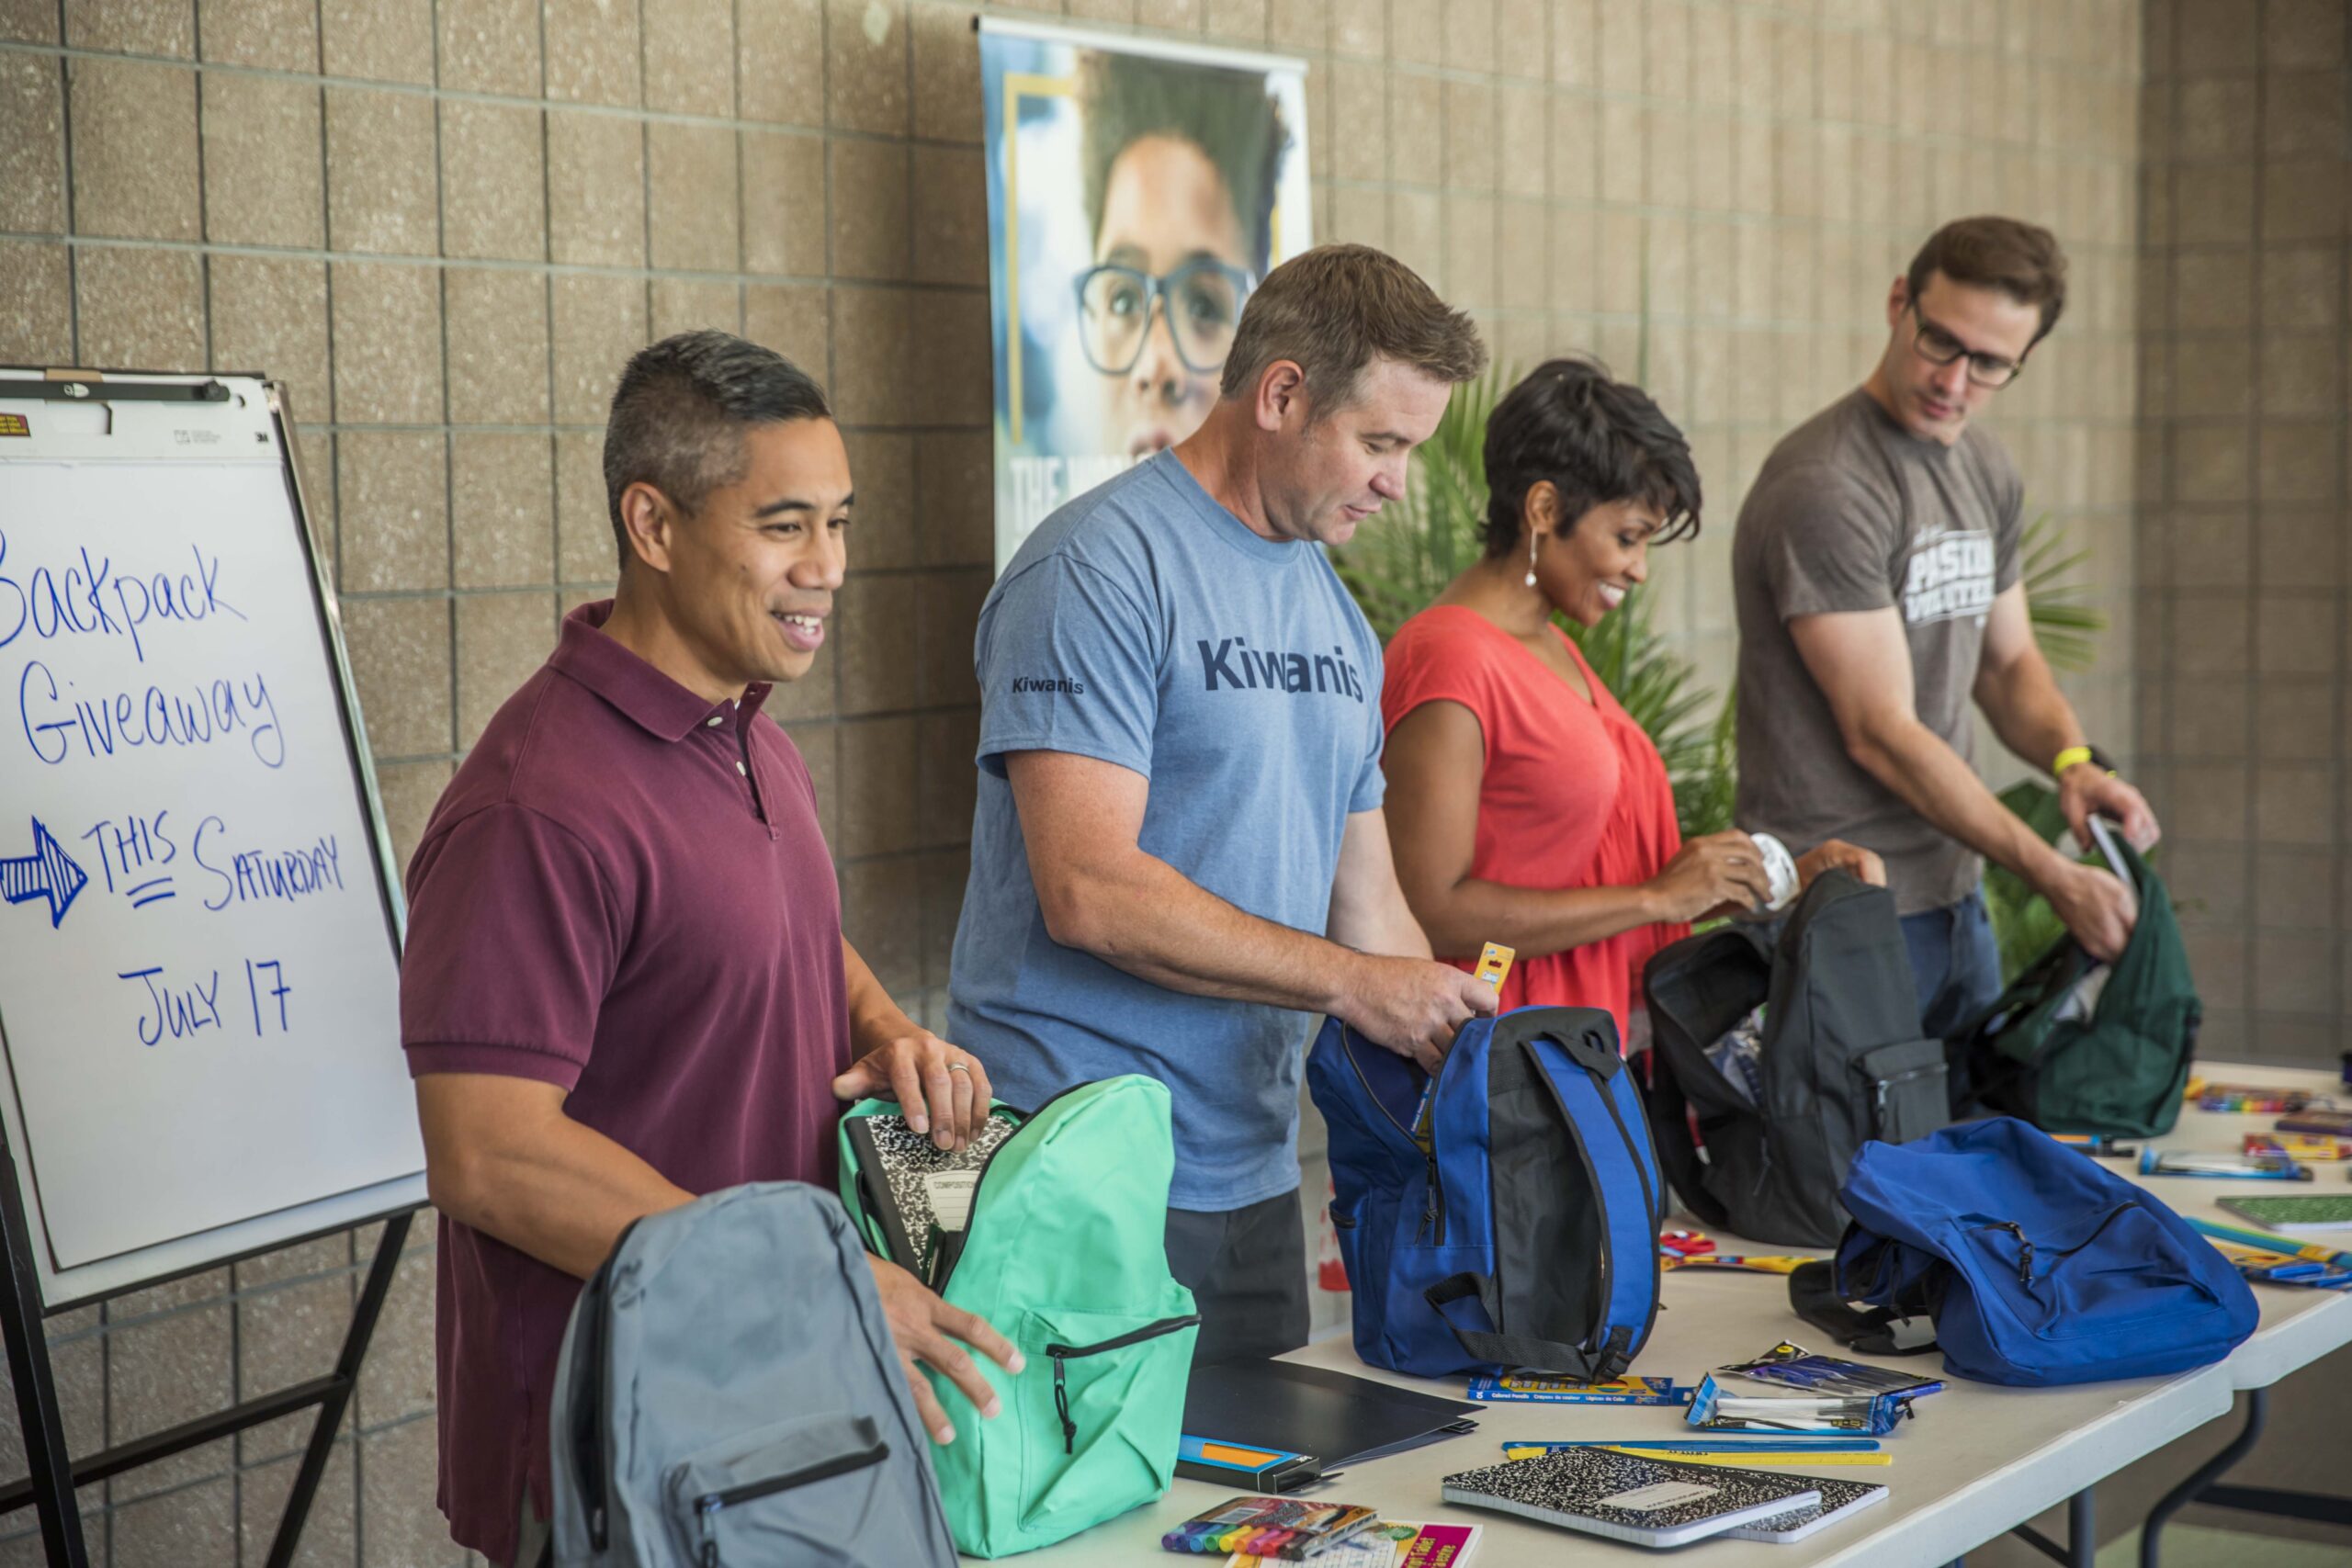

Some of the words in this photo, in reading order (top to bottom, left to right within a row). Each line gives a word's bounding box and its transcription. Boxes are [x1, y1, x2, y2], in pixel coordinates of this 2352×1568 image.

[1012, 676, 1084, 695] Kiwanis
[1197, 637, 1363, 704] Kiwanis
[20, 660, 285, 769] Giveaway
[81, 810, 176, 894] THIS
[118, 965, 221, 1047] JULY
[245, 958, 291, 1037] 17
